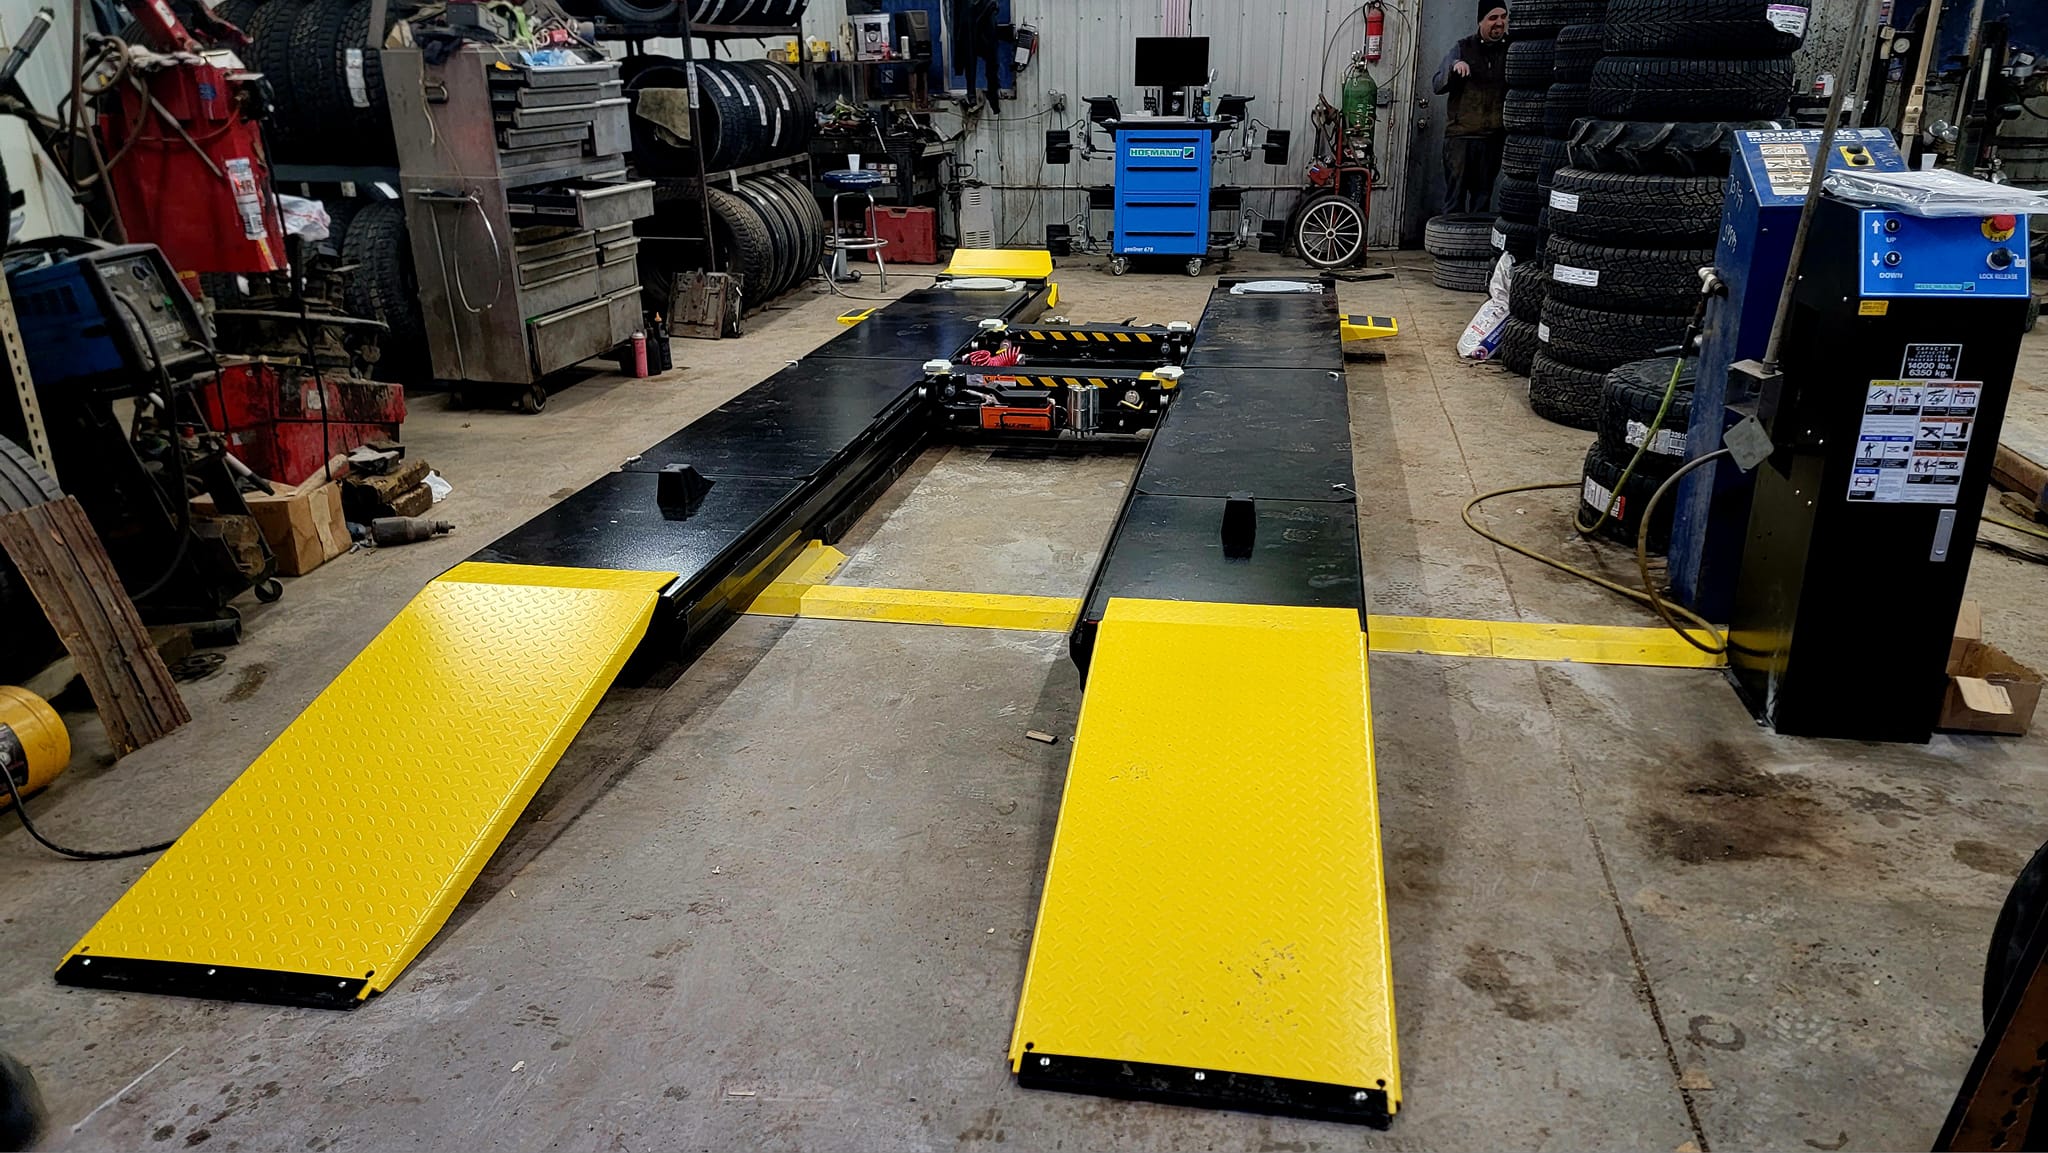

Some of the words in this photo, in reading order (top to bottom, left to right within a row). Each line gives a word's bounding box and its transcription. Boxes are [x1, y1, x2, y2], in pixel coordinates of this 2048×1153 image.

[1130, 148, 1181, 157] HOFMANN
[1937, 362, 1953, 370] lbs.
[1908, 369, 1932, 377] 6350
[1934, 369, 1949, 378] kg.
